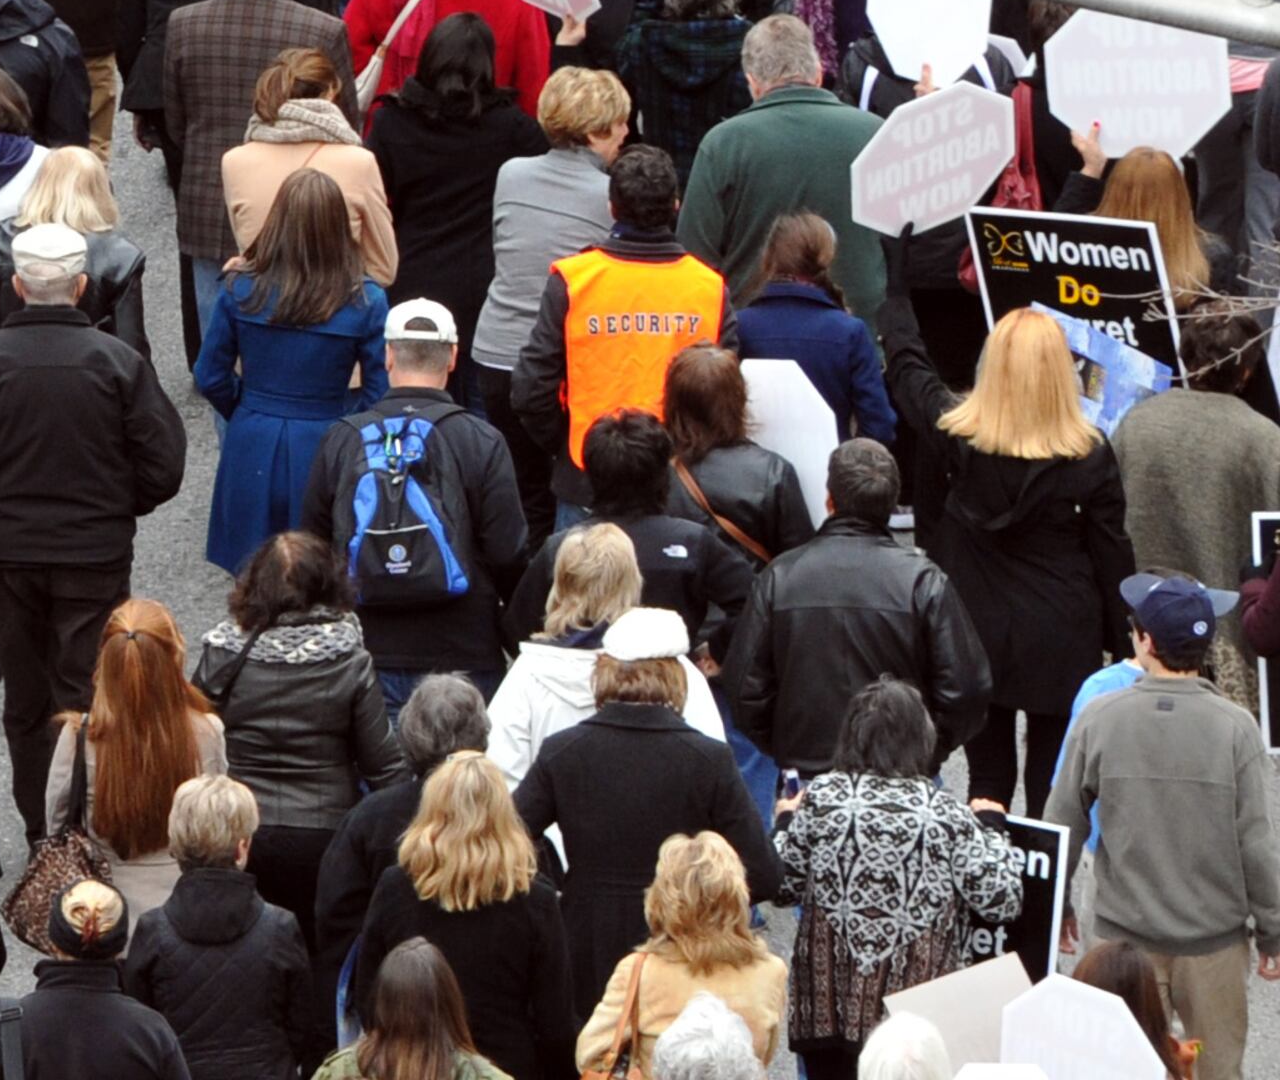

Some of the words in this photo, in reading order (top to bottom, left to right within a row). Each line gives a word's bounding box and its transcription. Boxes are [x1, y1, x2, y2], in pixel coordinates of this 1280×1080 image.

[1023, 229, 1152, 272] Women
[1057, 274, 1101, 307] Do
[587, 313, 701, 336] SECURITY
